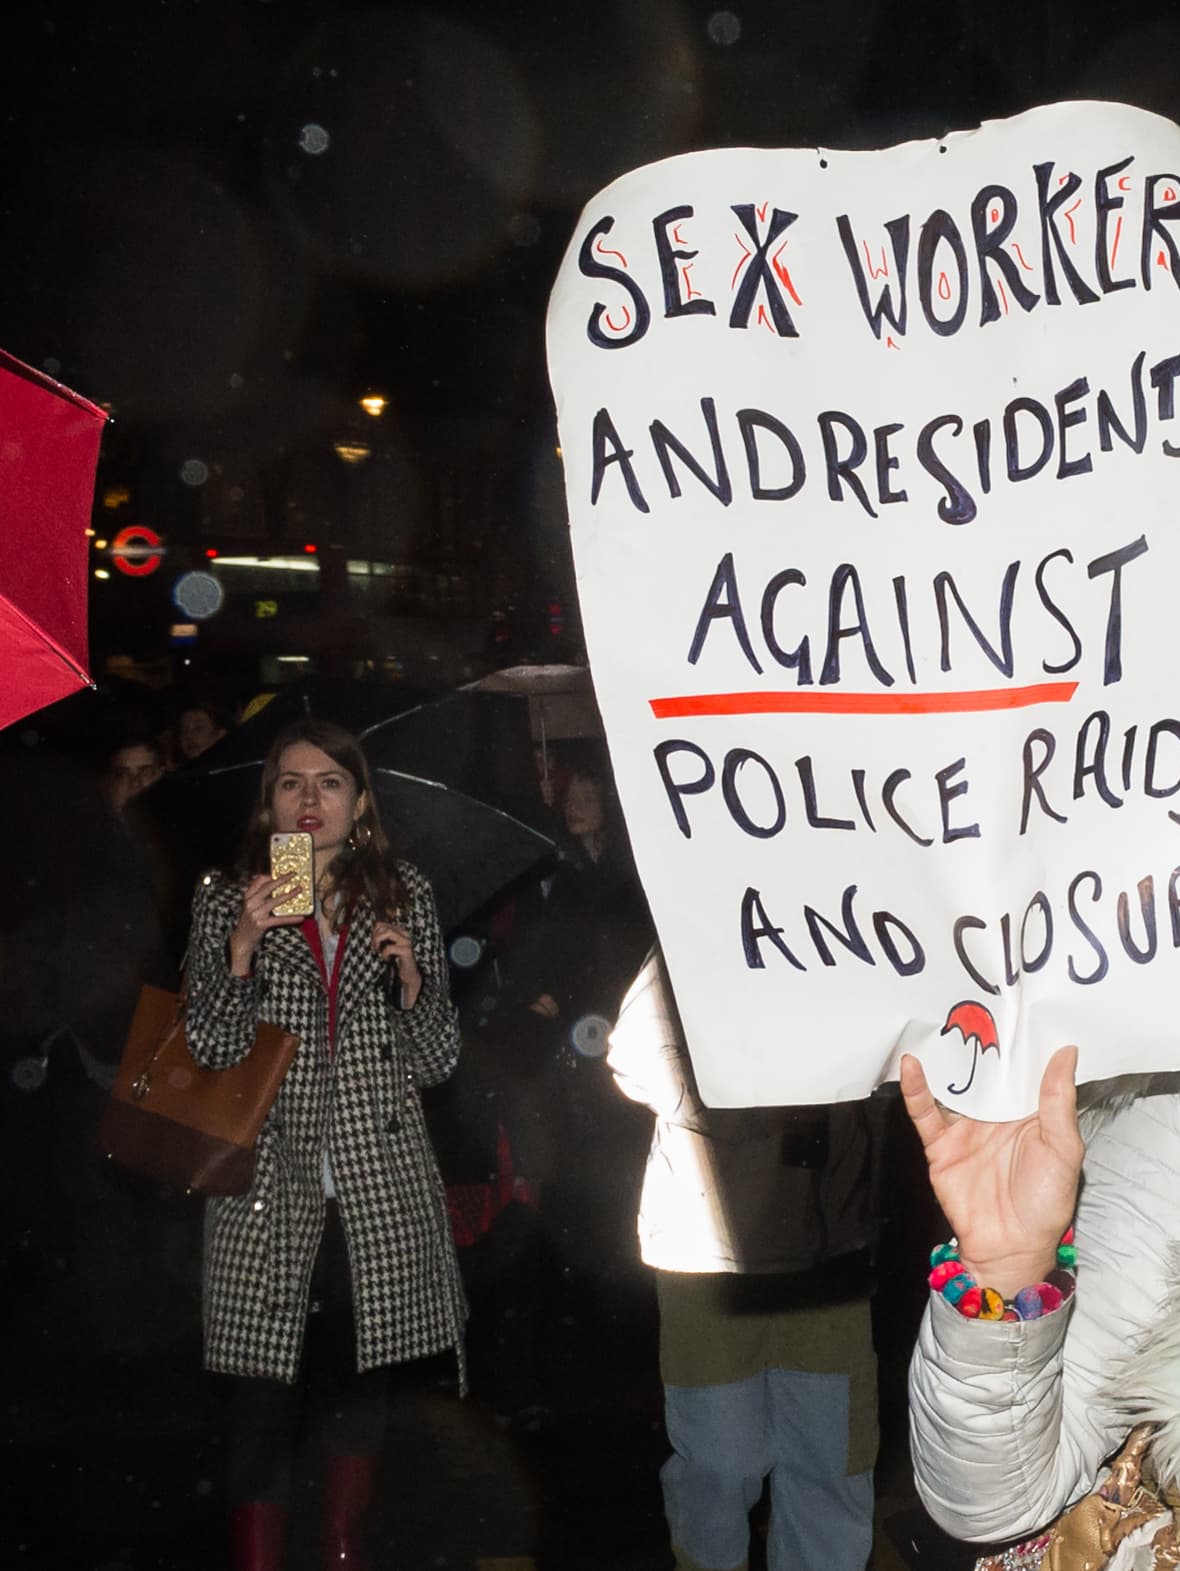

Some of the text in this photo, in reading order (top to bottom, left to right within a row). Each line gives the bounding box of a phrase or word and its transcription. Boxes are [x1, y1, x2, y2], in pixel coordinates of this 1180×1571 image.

[578, 204, 801, 349] SEX
[688, 534, 1149, 687] AGAINST
[653, 739, 981, 847] POLICE
[741, 884, 926, 977] AND
